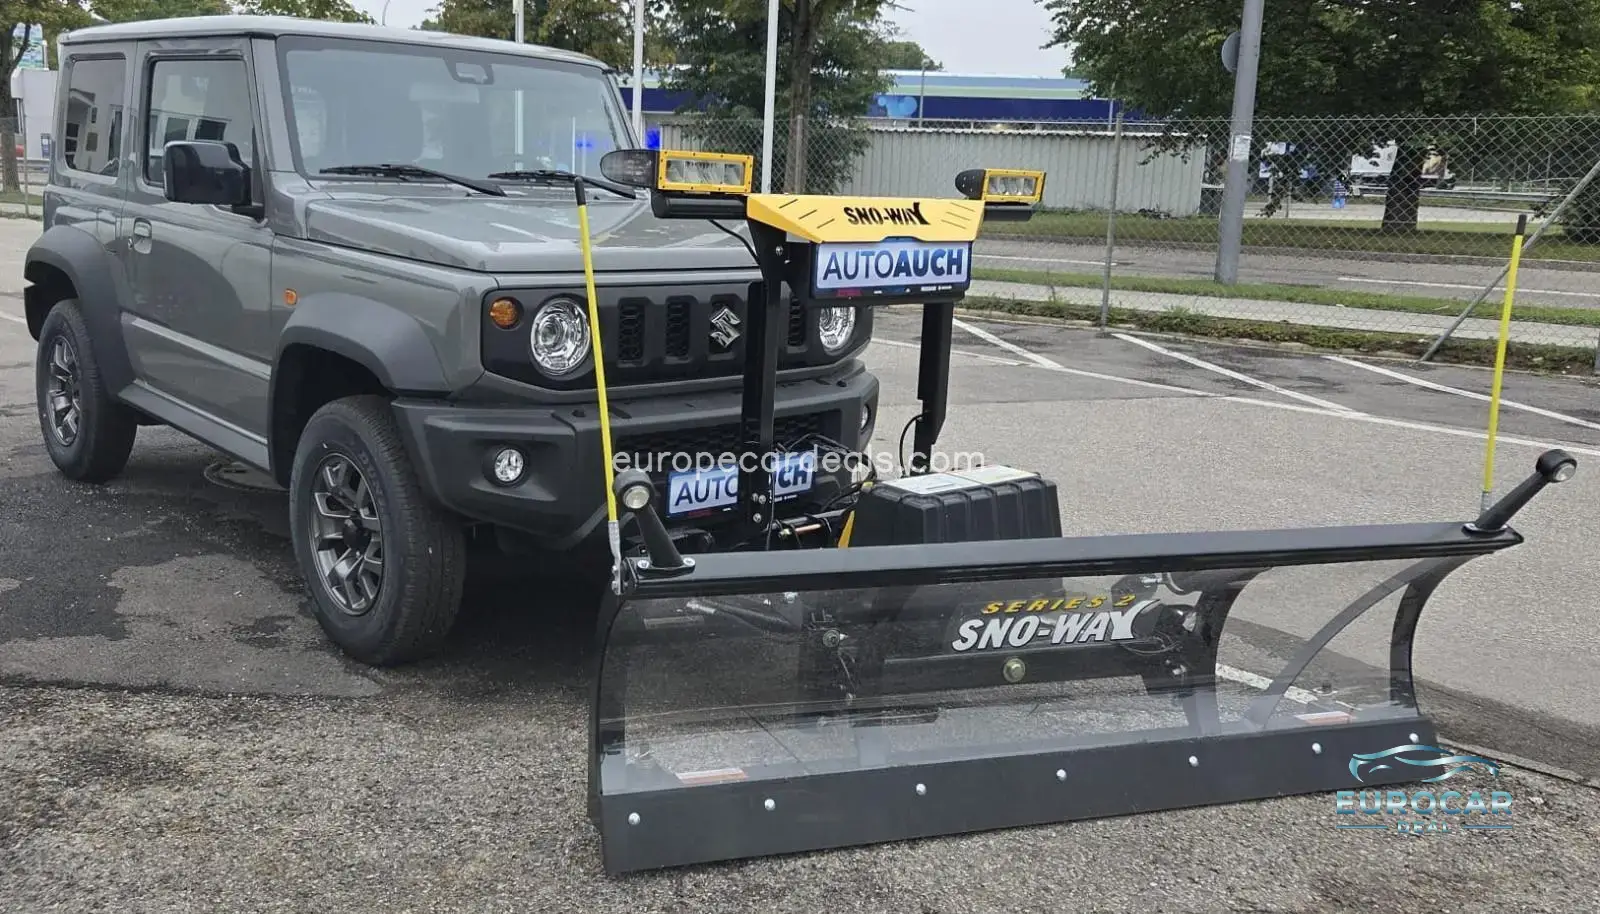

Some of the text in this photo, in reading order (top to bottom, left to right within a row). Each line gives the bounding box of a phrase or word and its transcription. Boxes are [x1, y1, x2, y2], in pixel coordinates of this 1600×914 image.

[843, 202, 930, 225] SNO-WAY
[824, 248, 963, 281] AUTOAUCH
[982, 593, 1136, 614] SERIES 2
[951, 598, 1161, 651] SNO-WAY
